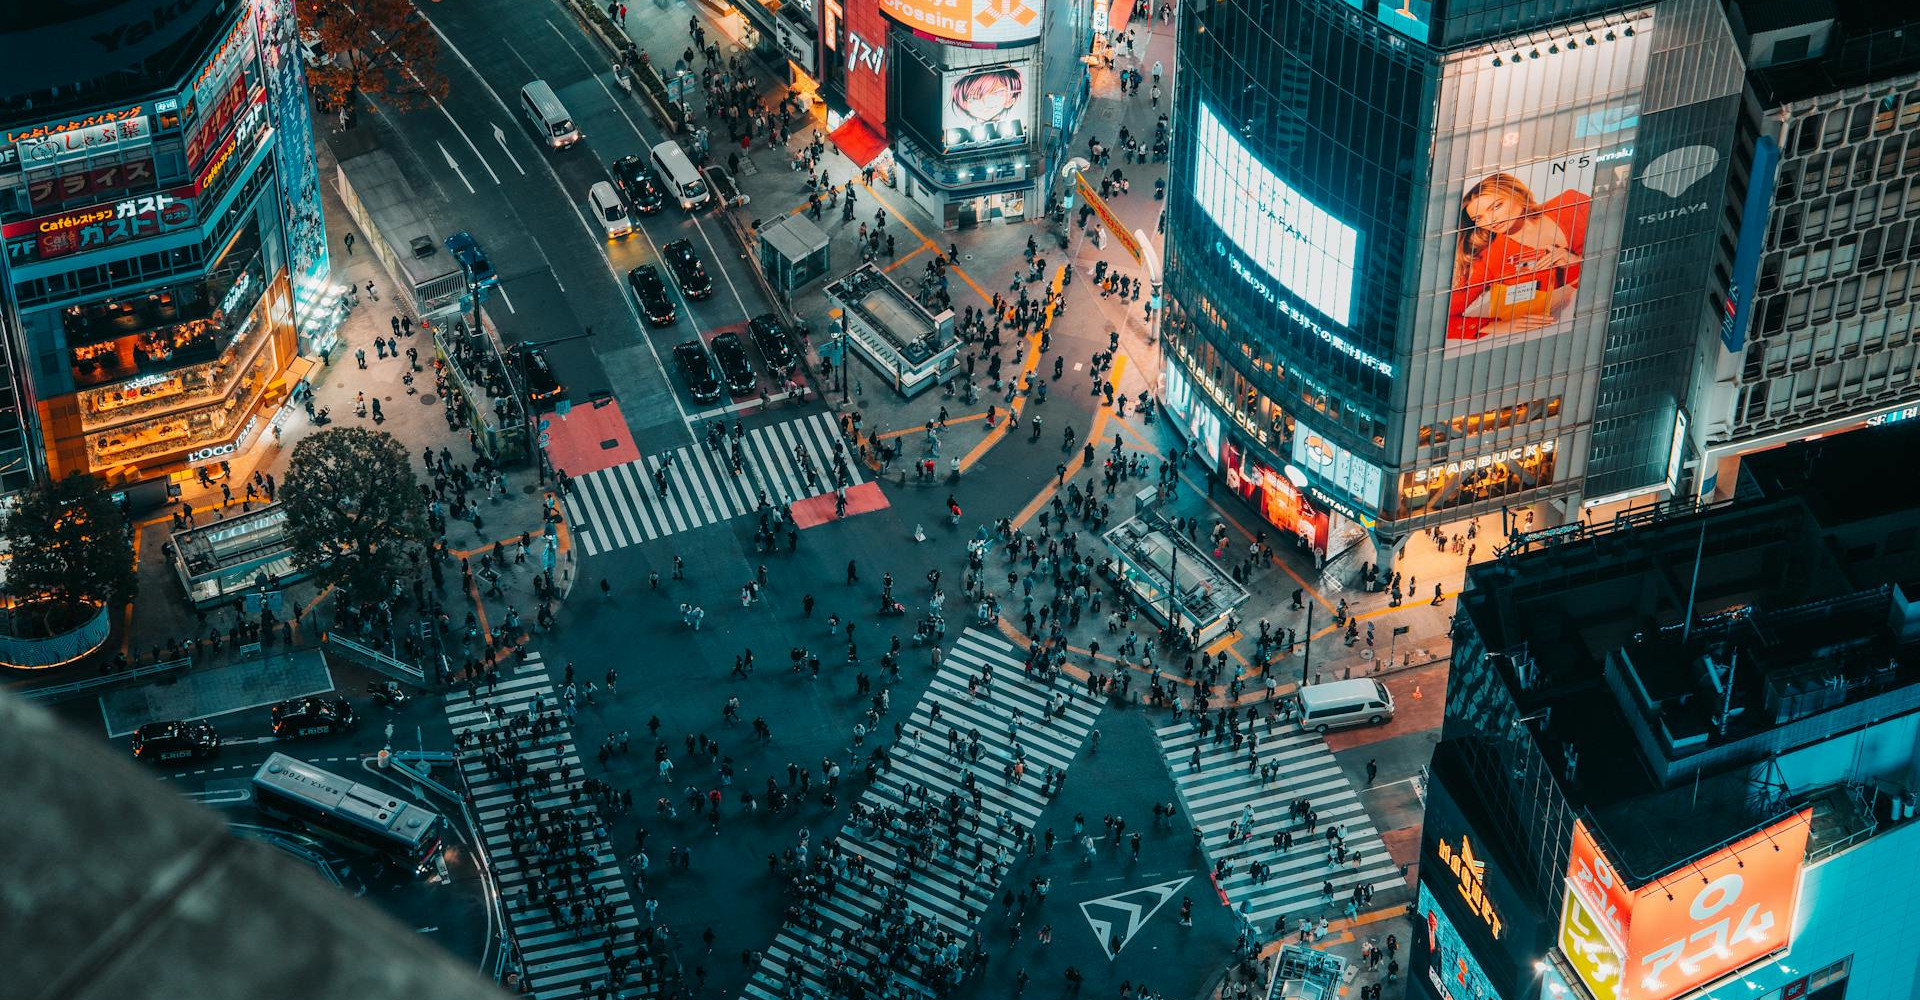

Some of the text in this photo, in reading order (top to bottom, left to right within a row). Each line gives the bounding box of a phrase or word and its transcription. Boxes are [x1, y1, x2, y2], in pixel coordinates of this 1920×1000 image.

[30, 162, 150, 201] プライス
[117, 195, 174, 218] ガスト
[1638, 202, 1709, 225] TSUTAYA
[8, 240, 36, 257] 7F
[79, 216, 153, 247] ガスト
[1180, 344, 1267, 443] STARBUCKS
[1415, 441, 1554, 482] STARBUCKS
[1312, 488, 1355, 518] TSUTAYA
[1576, 857, 1622, 935] アコム
[1641, 903, 1775, 985] アコム
